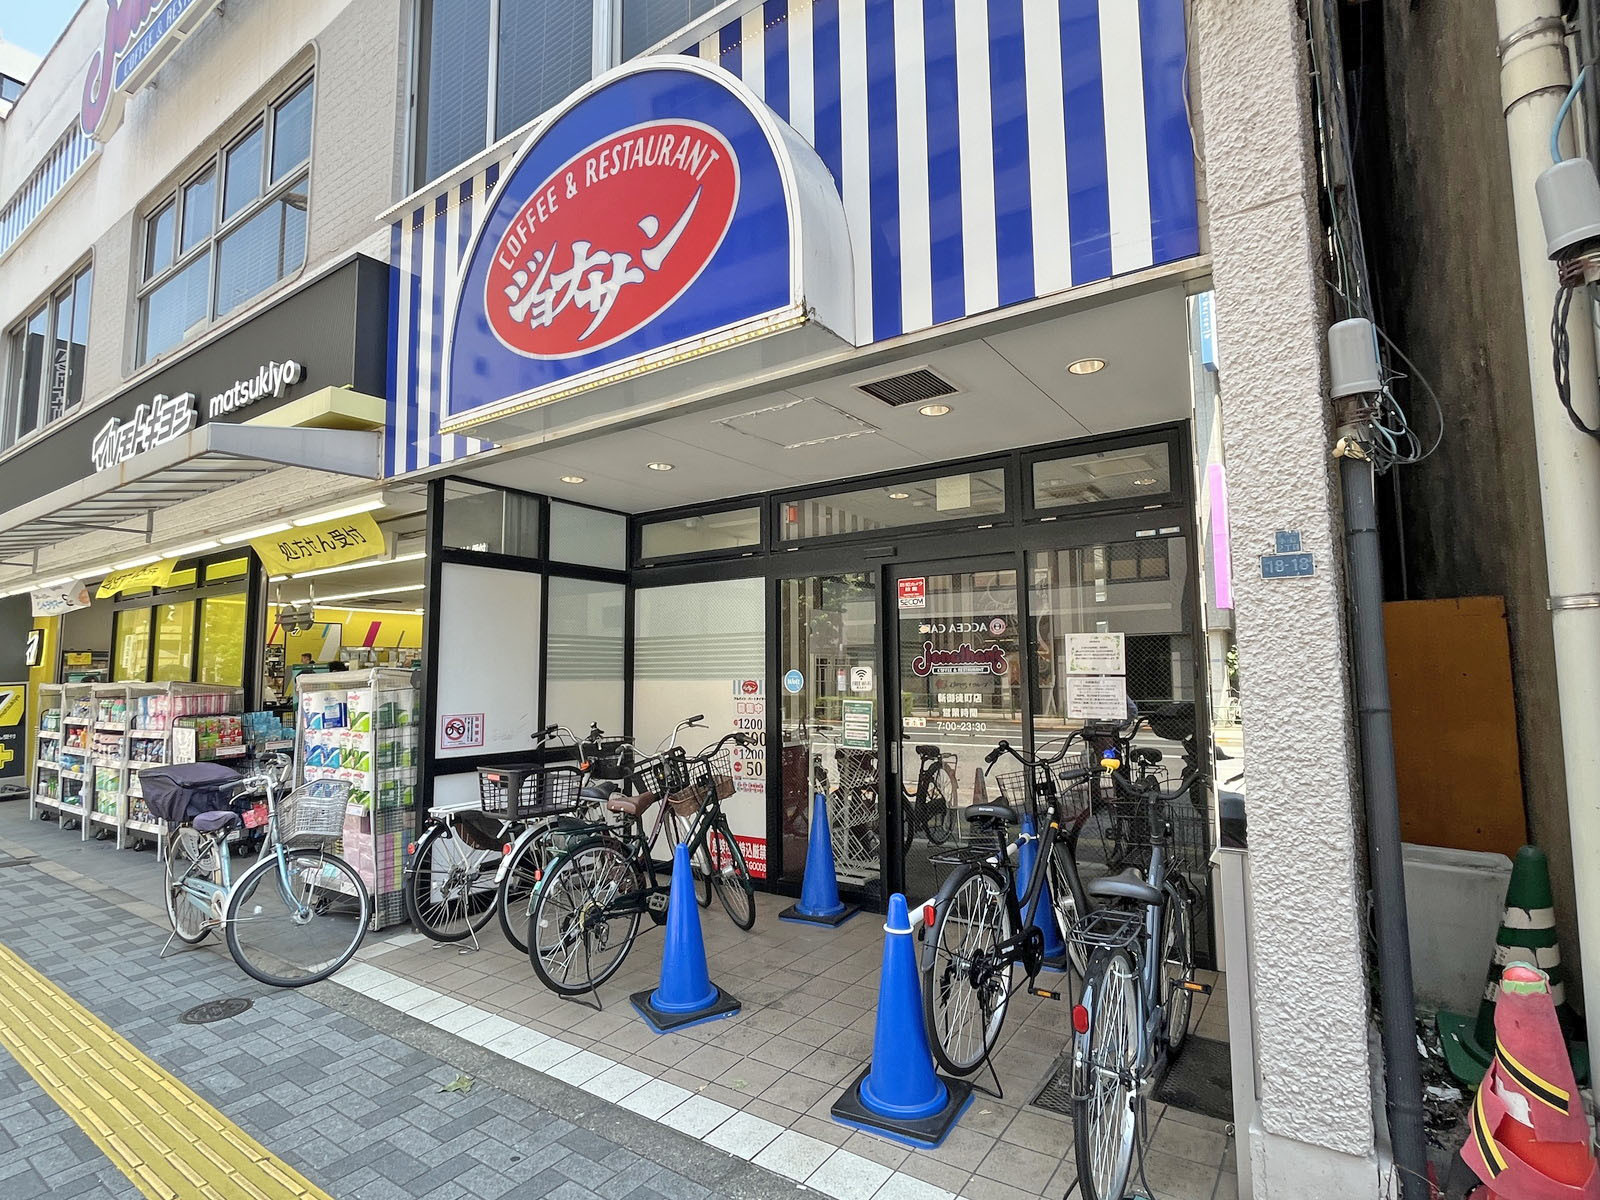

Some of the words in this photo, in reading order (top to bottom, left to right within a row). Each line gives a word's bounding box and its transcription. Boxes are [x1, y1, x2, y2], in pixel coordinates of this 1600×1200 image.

[123, 30, 156, 76] COFFEE
[155, 21, 165, 39] &
[497, 184, 560, 271] COFFEE
[565, 170, 578, 200] &
[584, 133, 720, 188] RESTAURANT
[503, 184, 703, 342] ジョナサン
[209, 359, 297, 419] matsukiyo
[278, 525, 368, 562] 処方せん受付
[900, 598, 924, 606] SECOM
[738, 717, 763, 730] 1200
[746, 761, 763, 776] 50
